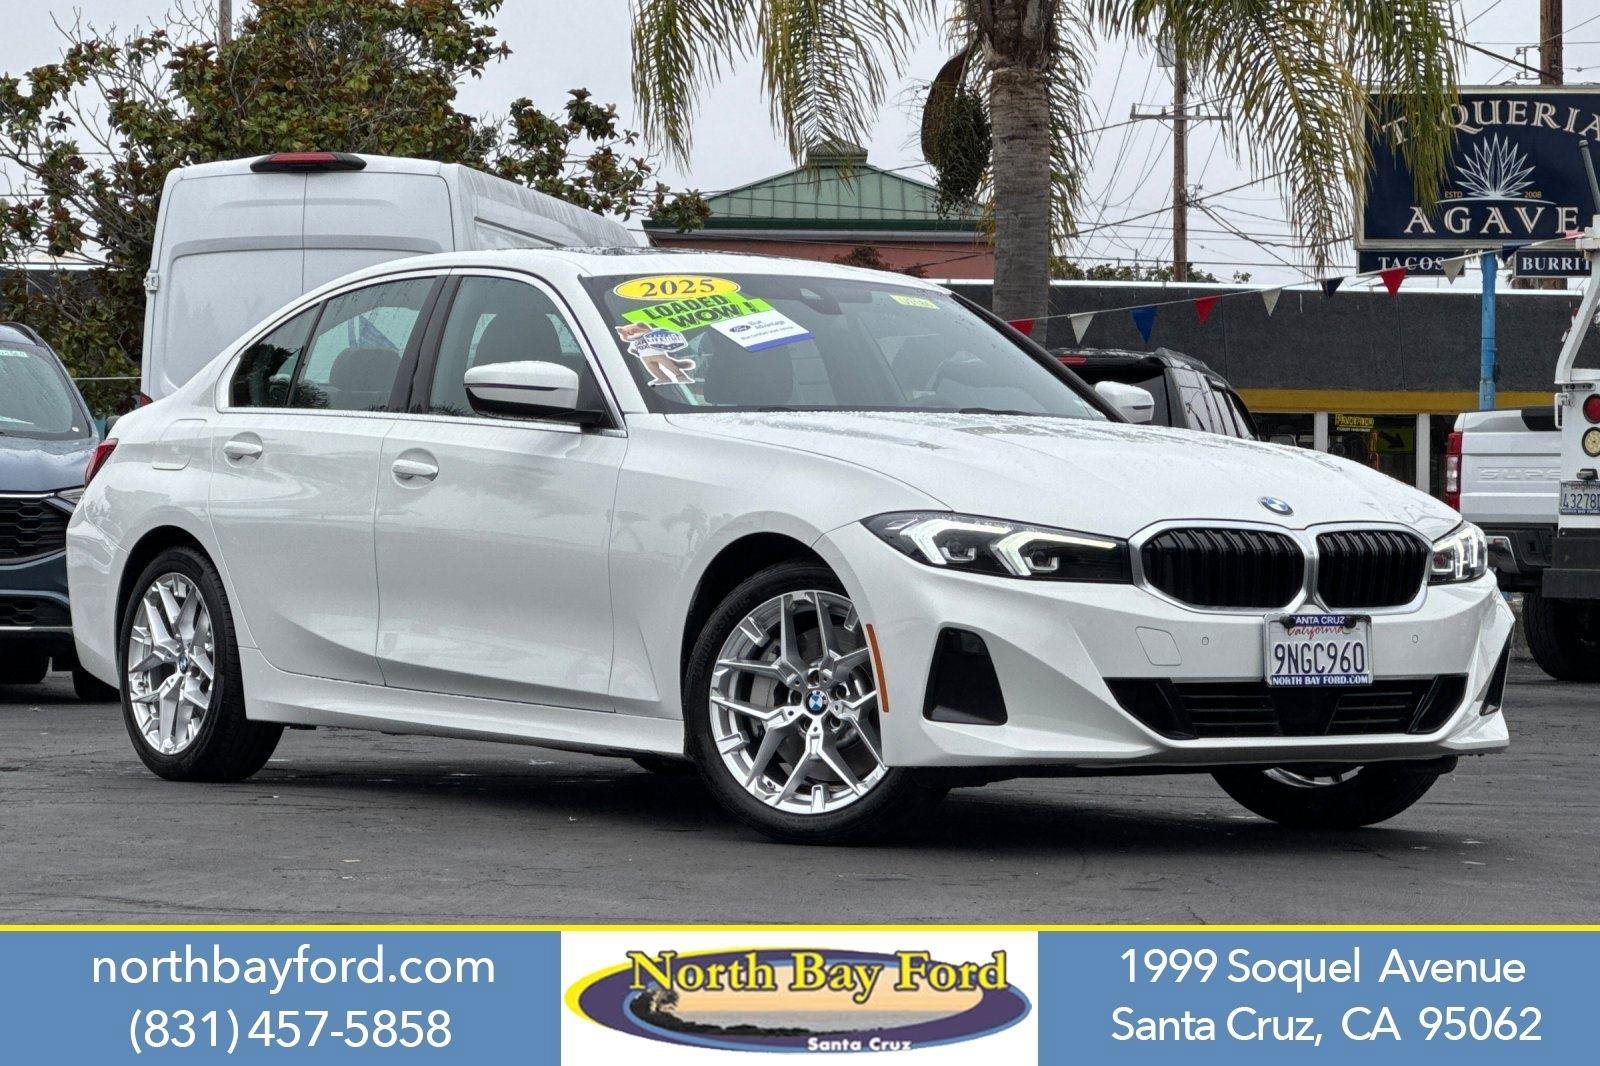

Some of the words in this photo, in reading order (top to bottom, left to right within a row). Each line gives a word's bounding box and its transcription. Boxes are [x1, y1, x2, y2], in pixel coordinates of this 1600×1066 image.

[1382, 100, 1600, 145] TQUERIA
[1444, 191, 1463, 199] ESTD
[1524, 191, 1542, 199] 2008
[1404, 206, 1580, 234] AGAVE
[1378, 256, 1445, 271] TACOS
[640, 279, 715, 298] 2025
[642, 294, 729, 320] LOADED
[1293, 616, 1320, 625] ANTA
[1322, 615, 1345, 625] CRUZ
[1288, 625, 1344, 639] California
[1274, 642, 1365, 674] 9NGC960
[1273, 675, 1302, 685] NORTH
[1305, 675, 1320, 685] BAY
[1323, 675, 1368, 685] FORD.COM
